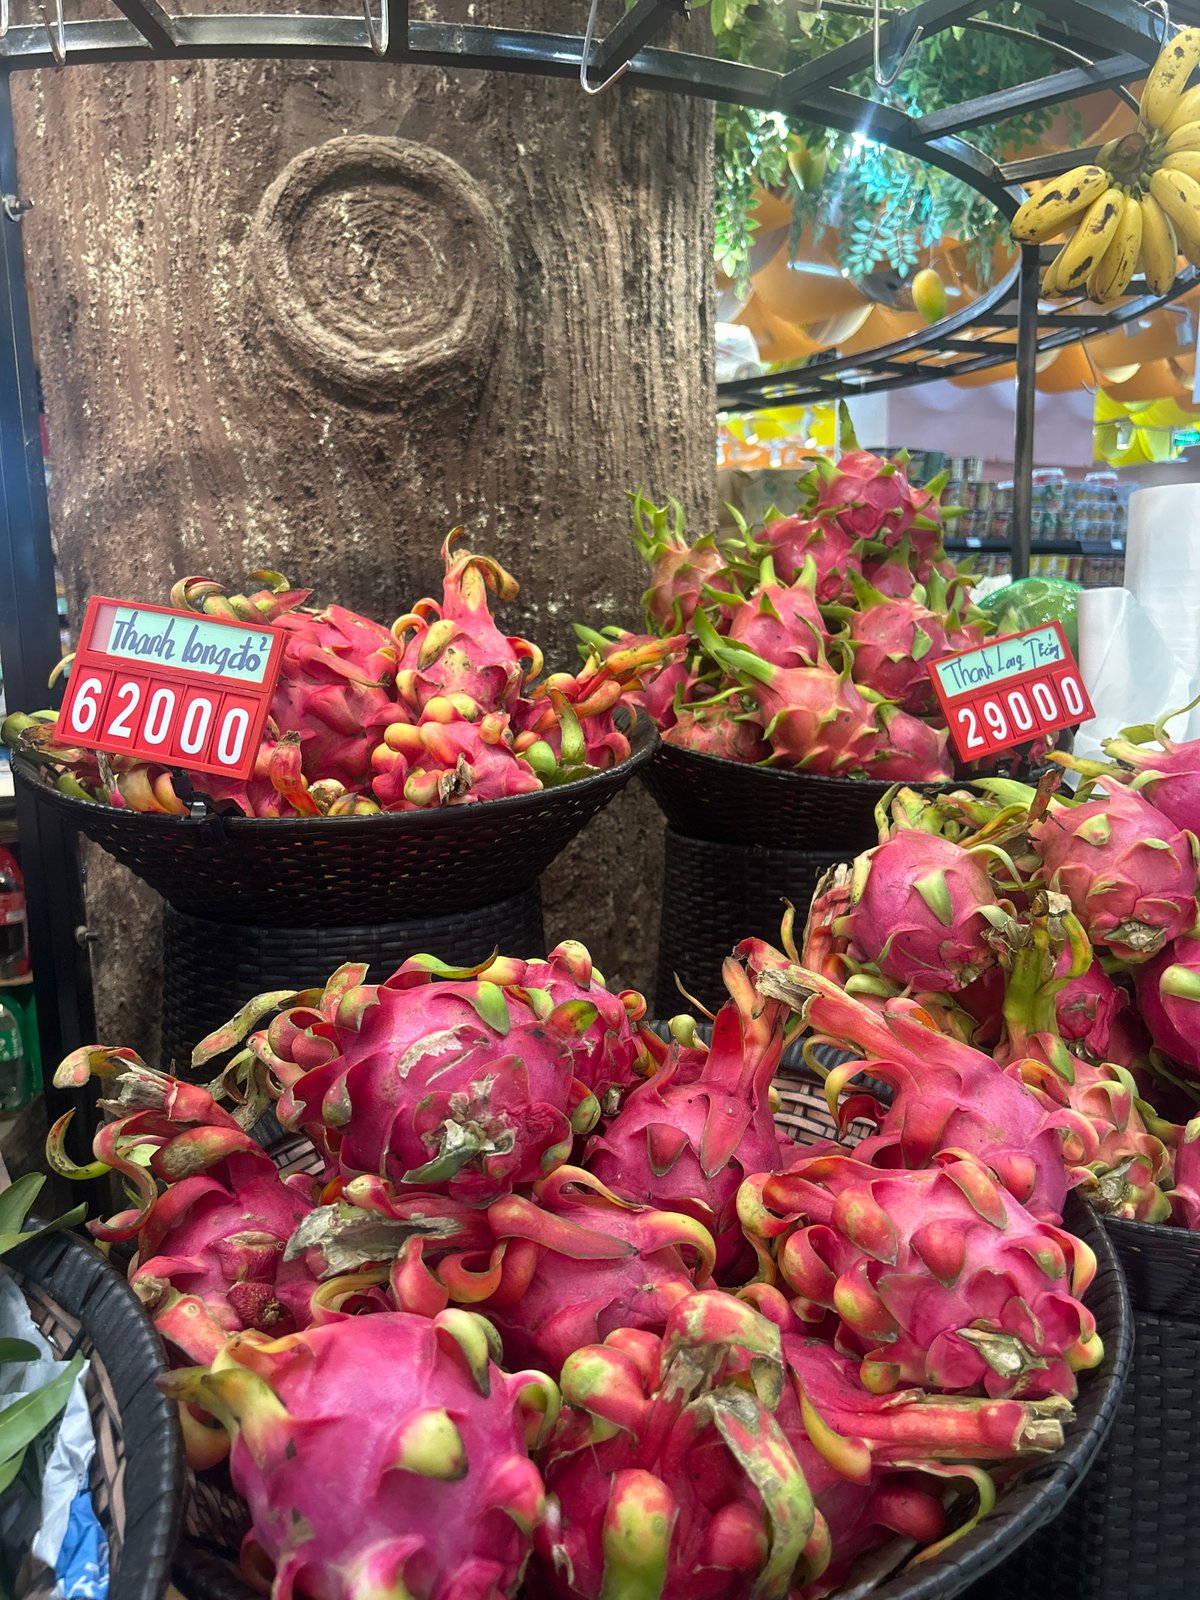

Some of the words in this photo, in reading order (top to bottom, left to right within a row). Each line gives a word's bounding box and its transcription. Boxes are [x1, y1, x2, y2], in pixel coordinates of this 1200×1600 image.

[111, 611, 175, 660] Thanh
[942, 650, 994, 689] Thanh
[71, 677, 249, 765] 62000
[957, 676, 1084, 748] 29000
